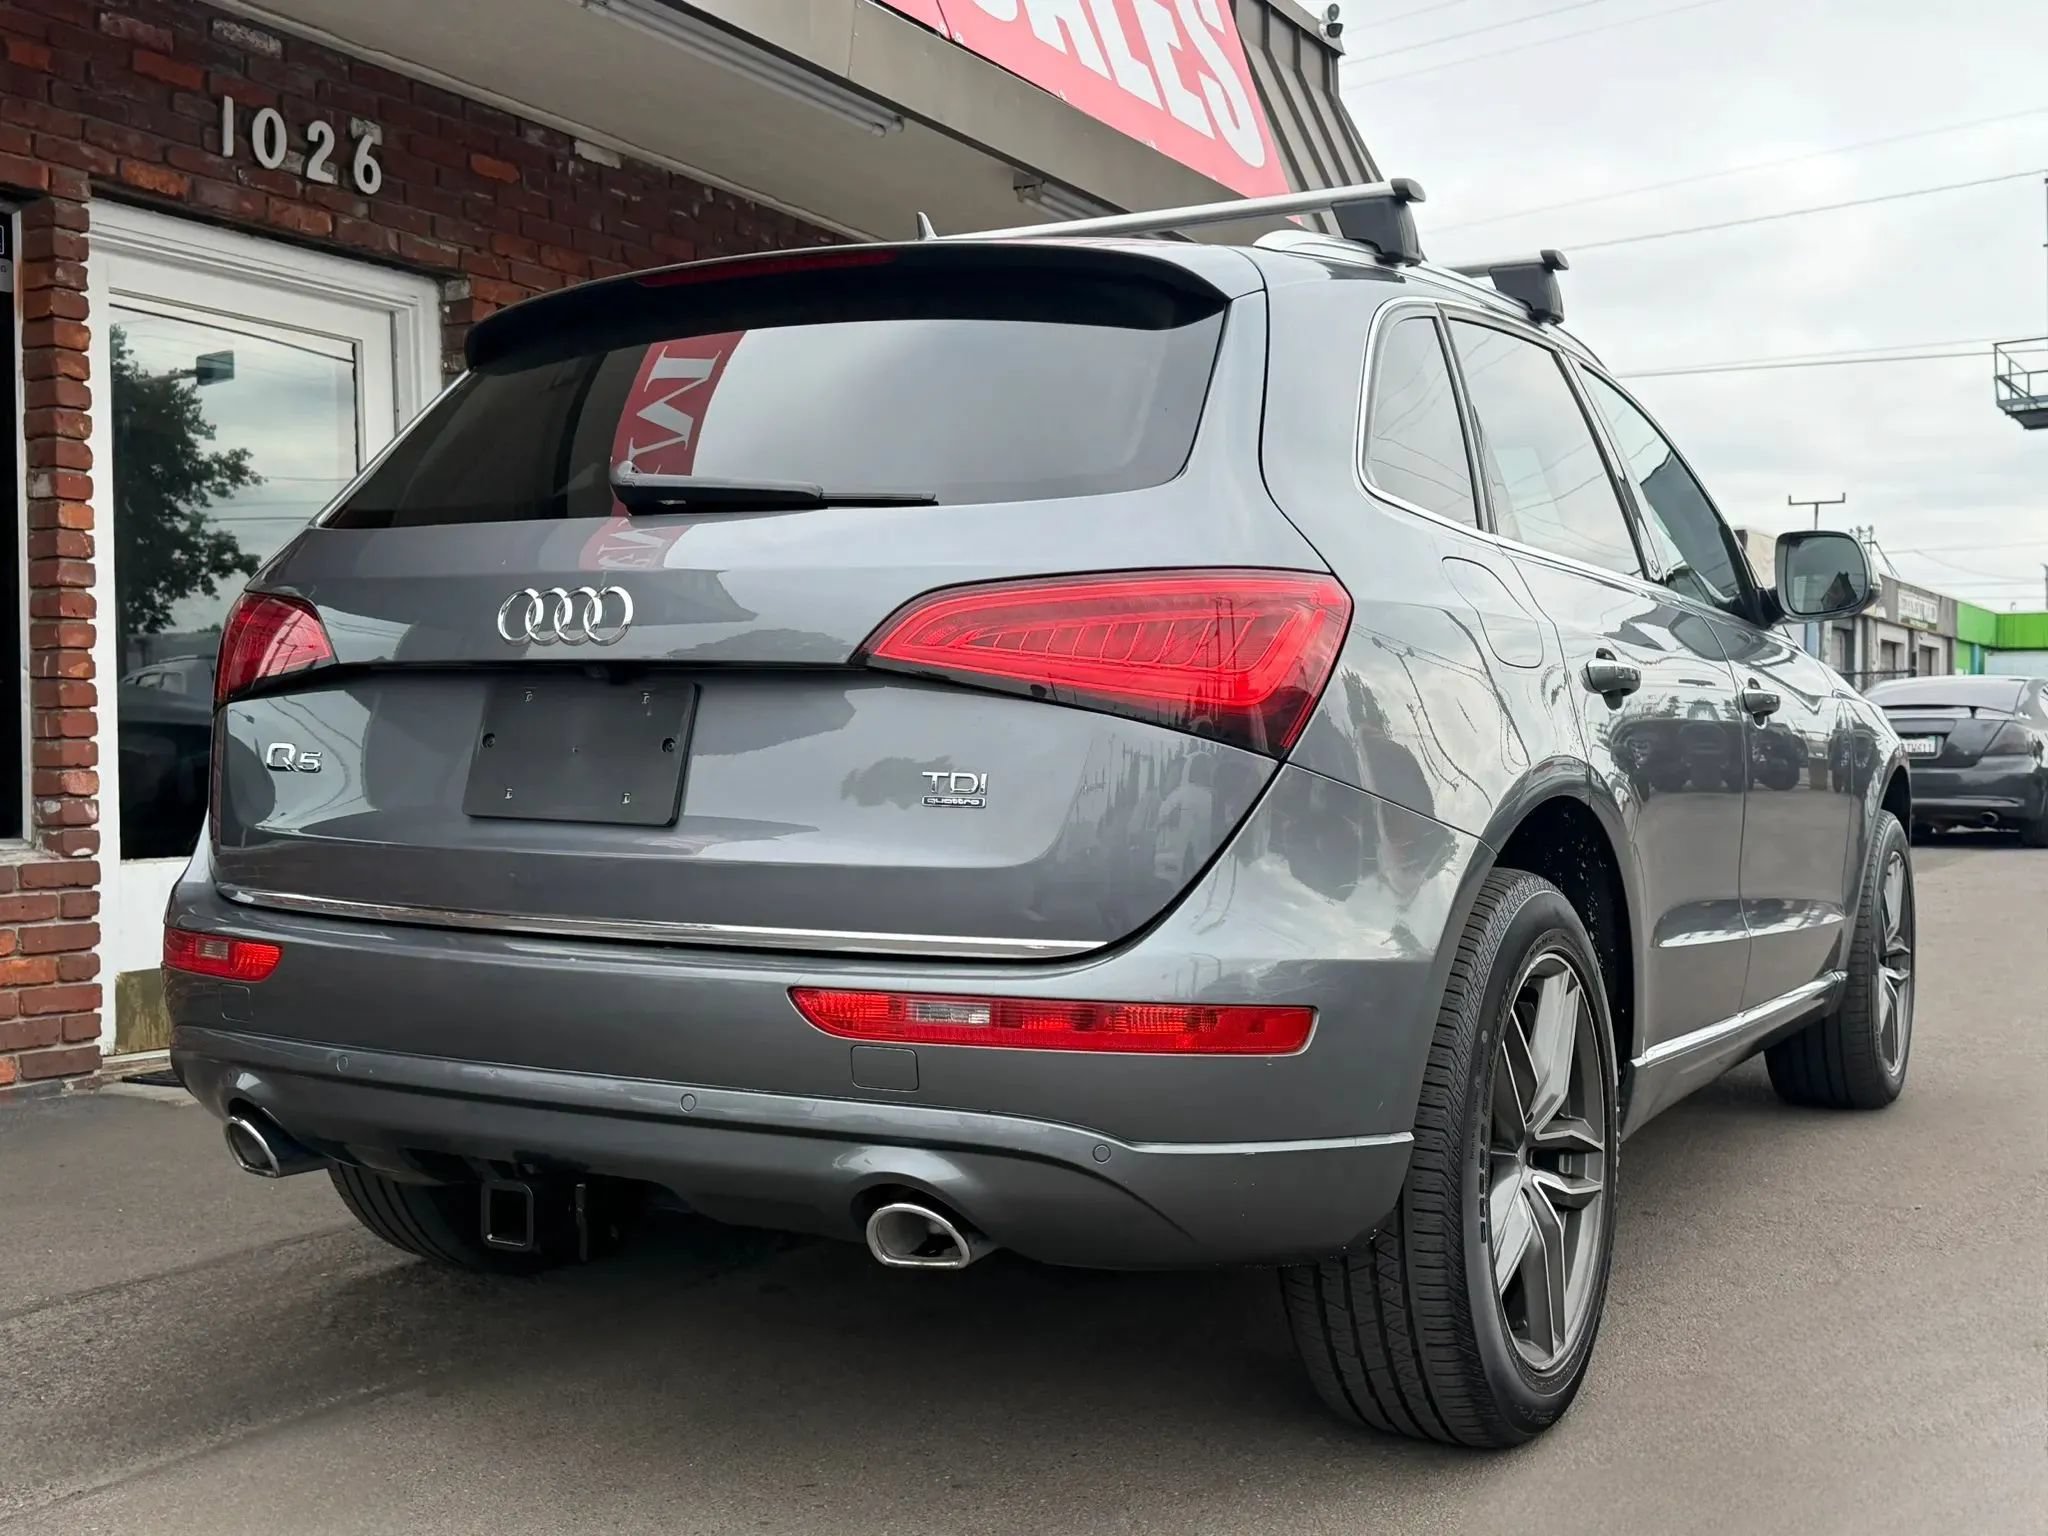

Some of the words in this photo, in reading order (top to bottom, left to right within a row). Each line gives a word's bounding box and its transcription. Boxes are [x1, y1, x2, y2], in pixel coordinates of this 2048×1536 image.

[971, 0, 1265, 168] LES
[223, 95, 382, 195] 1026
[266, 743, 321, 773] Q5
[922, 772, 987, 794] TDI
[926, 797, 981, 806] quattro
